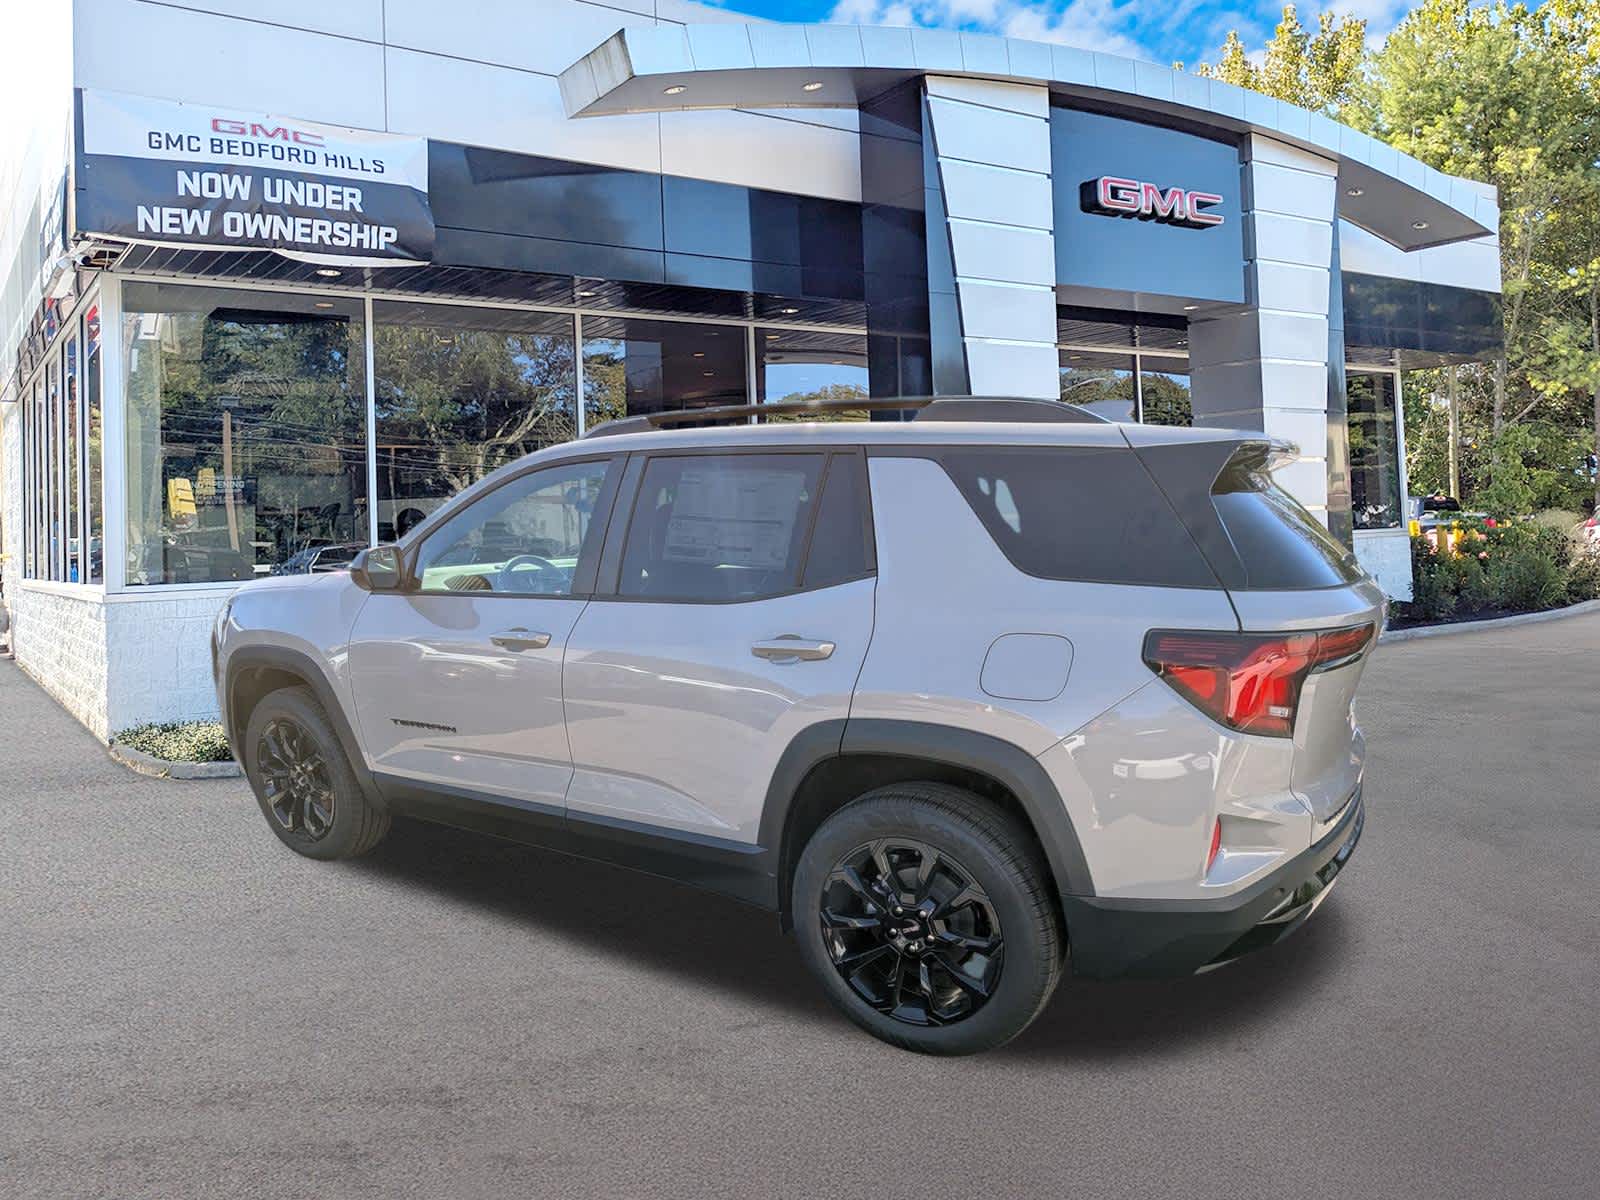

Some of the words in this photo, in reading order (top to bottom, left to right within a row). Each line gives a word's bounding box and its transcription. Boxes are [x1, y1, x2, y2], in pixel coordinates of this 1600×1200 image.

[148, 131, 201, 152] GMC
[210, 138, 316, 165] BEDFORD
[325, 153, 385, 174] HILLS
[211, 118, 326, 148] GMC
[177, 170, 252, 200] NOW
[263, 177, 364, 213] UNDER
[1097, 176, 1225, 224] GMC
[137, 205, 211, 236] NEW
[223, 211, 398, 250] OWNERSHIP
